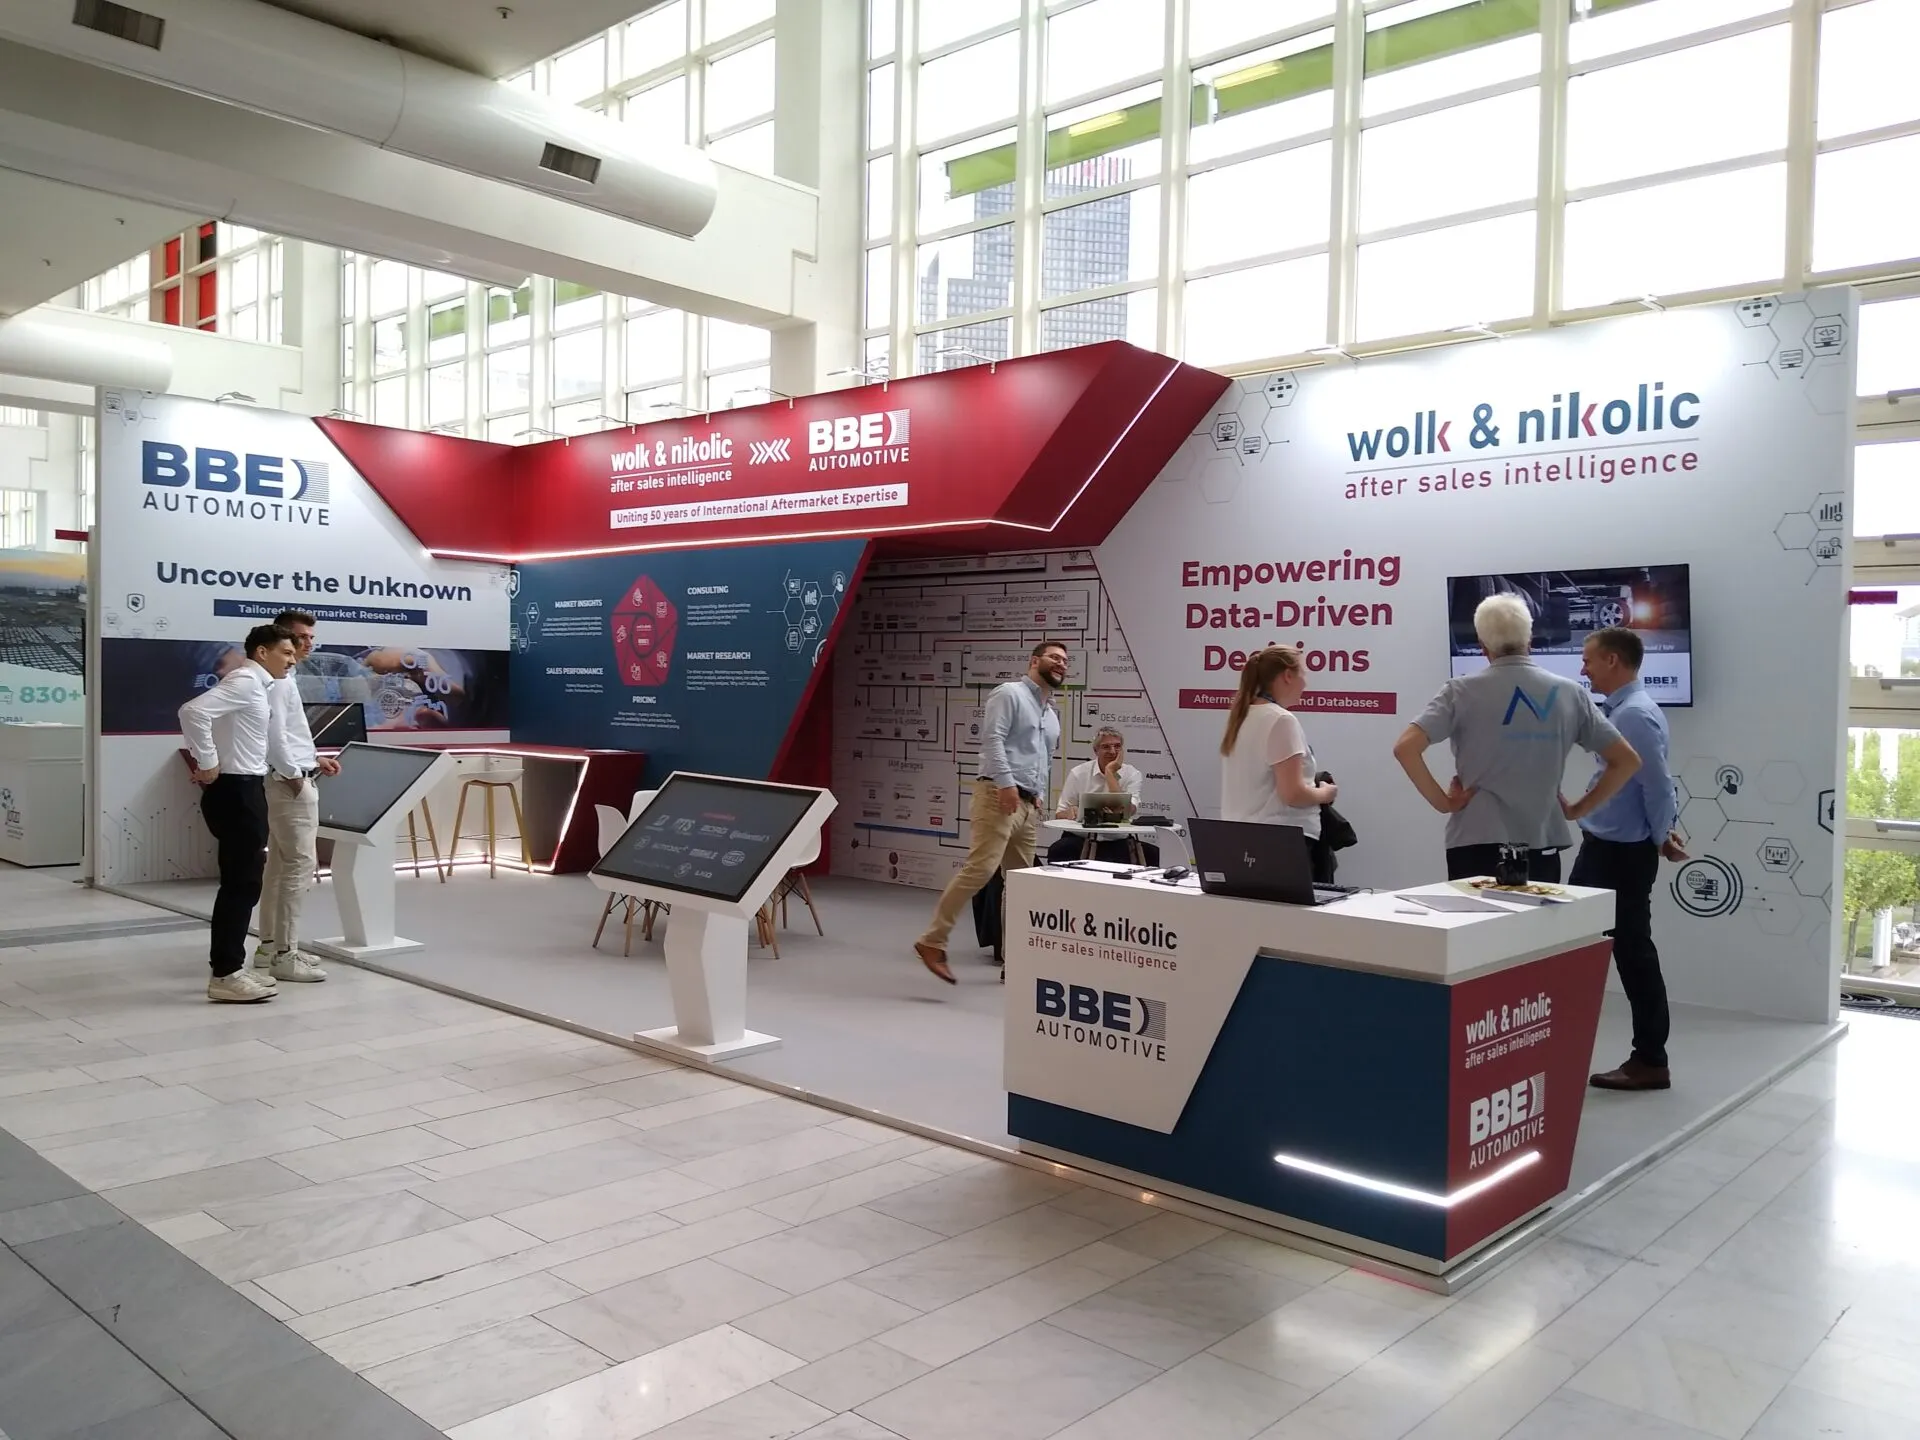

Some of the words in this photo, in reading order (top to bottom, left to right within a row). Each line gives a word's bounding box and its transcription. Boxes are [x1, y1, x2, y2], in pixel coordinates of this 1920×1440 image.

[808, 411, 885, 455] BBE
[1346, 409, 1452, 462] wolk
[1469, 403, 1501, 450] &
[1518, 381, 1701, 444] nikolic
[141, 440, 284, 499] BBE
[611, 443, 651, 472] wolk
[655, 440, 668, 467] &
[671, 432, 733, 464] nikolic
[808, 447, 910, 472] AUTOMOTIVE
[610, 479, 635, 494] after
[637, 475, 665, 490] sales
[667, 469, 733, 488] intelligence
[1345, 476, 1408, 500] after
[1418, 467, 1493, 493] sales
[1504, 452, 1699, 485] intelligence
[142, 490, 330, 527] AUTOMOTIVE
[616, 511, 649, 524] Uniting
[650, 510, 662, 521] 50
[663, 508, 689, 521] years
[690, 506, 700, 517] of
[703, 502, 769, 517] International
[771, 494, 839, 511] Aftermarket
[842, 489, 899, 506] Expertise
[156, 561, 284, 591] Uncover
[292, 570, 340, 593] the
[348, 574, 472, 602] Unknown
[1181, 548, 1401, 592] Empowering
[554, 600, 577, 608] MARKET
[577, 599, 603, 607] INSIGHTS
[687, 585, 729, 595] CONSULTING
[238, 604, 286, 615] Tailored
[359, 610, 408, 622] Research
[1185, 595, 1393, 629] Data-Driven
[546, 667, 562, 675] SALES
[563, 667, 604, 675] PERFORMANCE
[686, 651, 714, 660] MARKET
[715, 651, 751, 660] RESEARCH
[1203, 640, 1370, 673] Deons
[20, 686, 82, 703] 830+
[1643, 676, 1670, 685] BBE
[632, 695, 657, 704] PRICING
[1298, 696, 1315, 706] nd
[1318, 696, 1380, 708] Databases
[1243, 849, 1257, 868] hp
[1028, 908, 1077, 935] wolk
[1083, 912, 1097, 937] &
[1103, 917, 1178, 950] nikolic
[1028, 935, 1058, 949] after
[1061, 943, 1094, 957] sales
[1099, 946, 1177, 971] intelligence
[1036, 977, 1132, 1033] BBE
[1466, 1008, 1498, 1045] wolk
[1500, 1004, 1510, 1033] &
[1512, 991, 1552, 1029] nikolic
[1035, 1018, 1166, 1062] AUTOMOTIVE
[1465, 1050, 1485, 1069] after
[1486, 1042, 1508, 1062] sales
[1509, 1026, 1551, 1052] intelligence
[1469, 1079, 1528, 1147] BBE
[1469, 1115, 1545, 1170] AUTOMOTIVE
